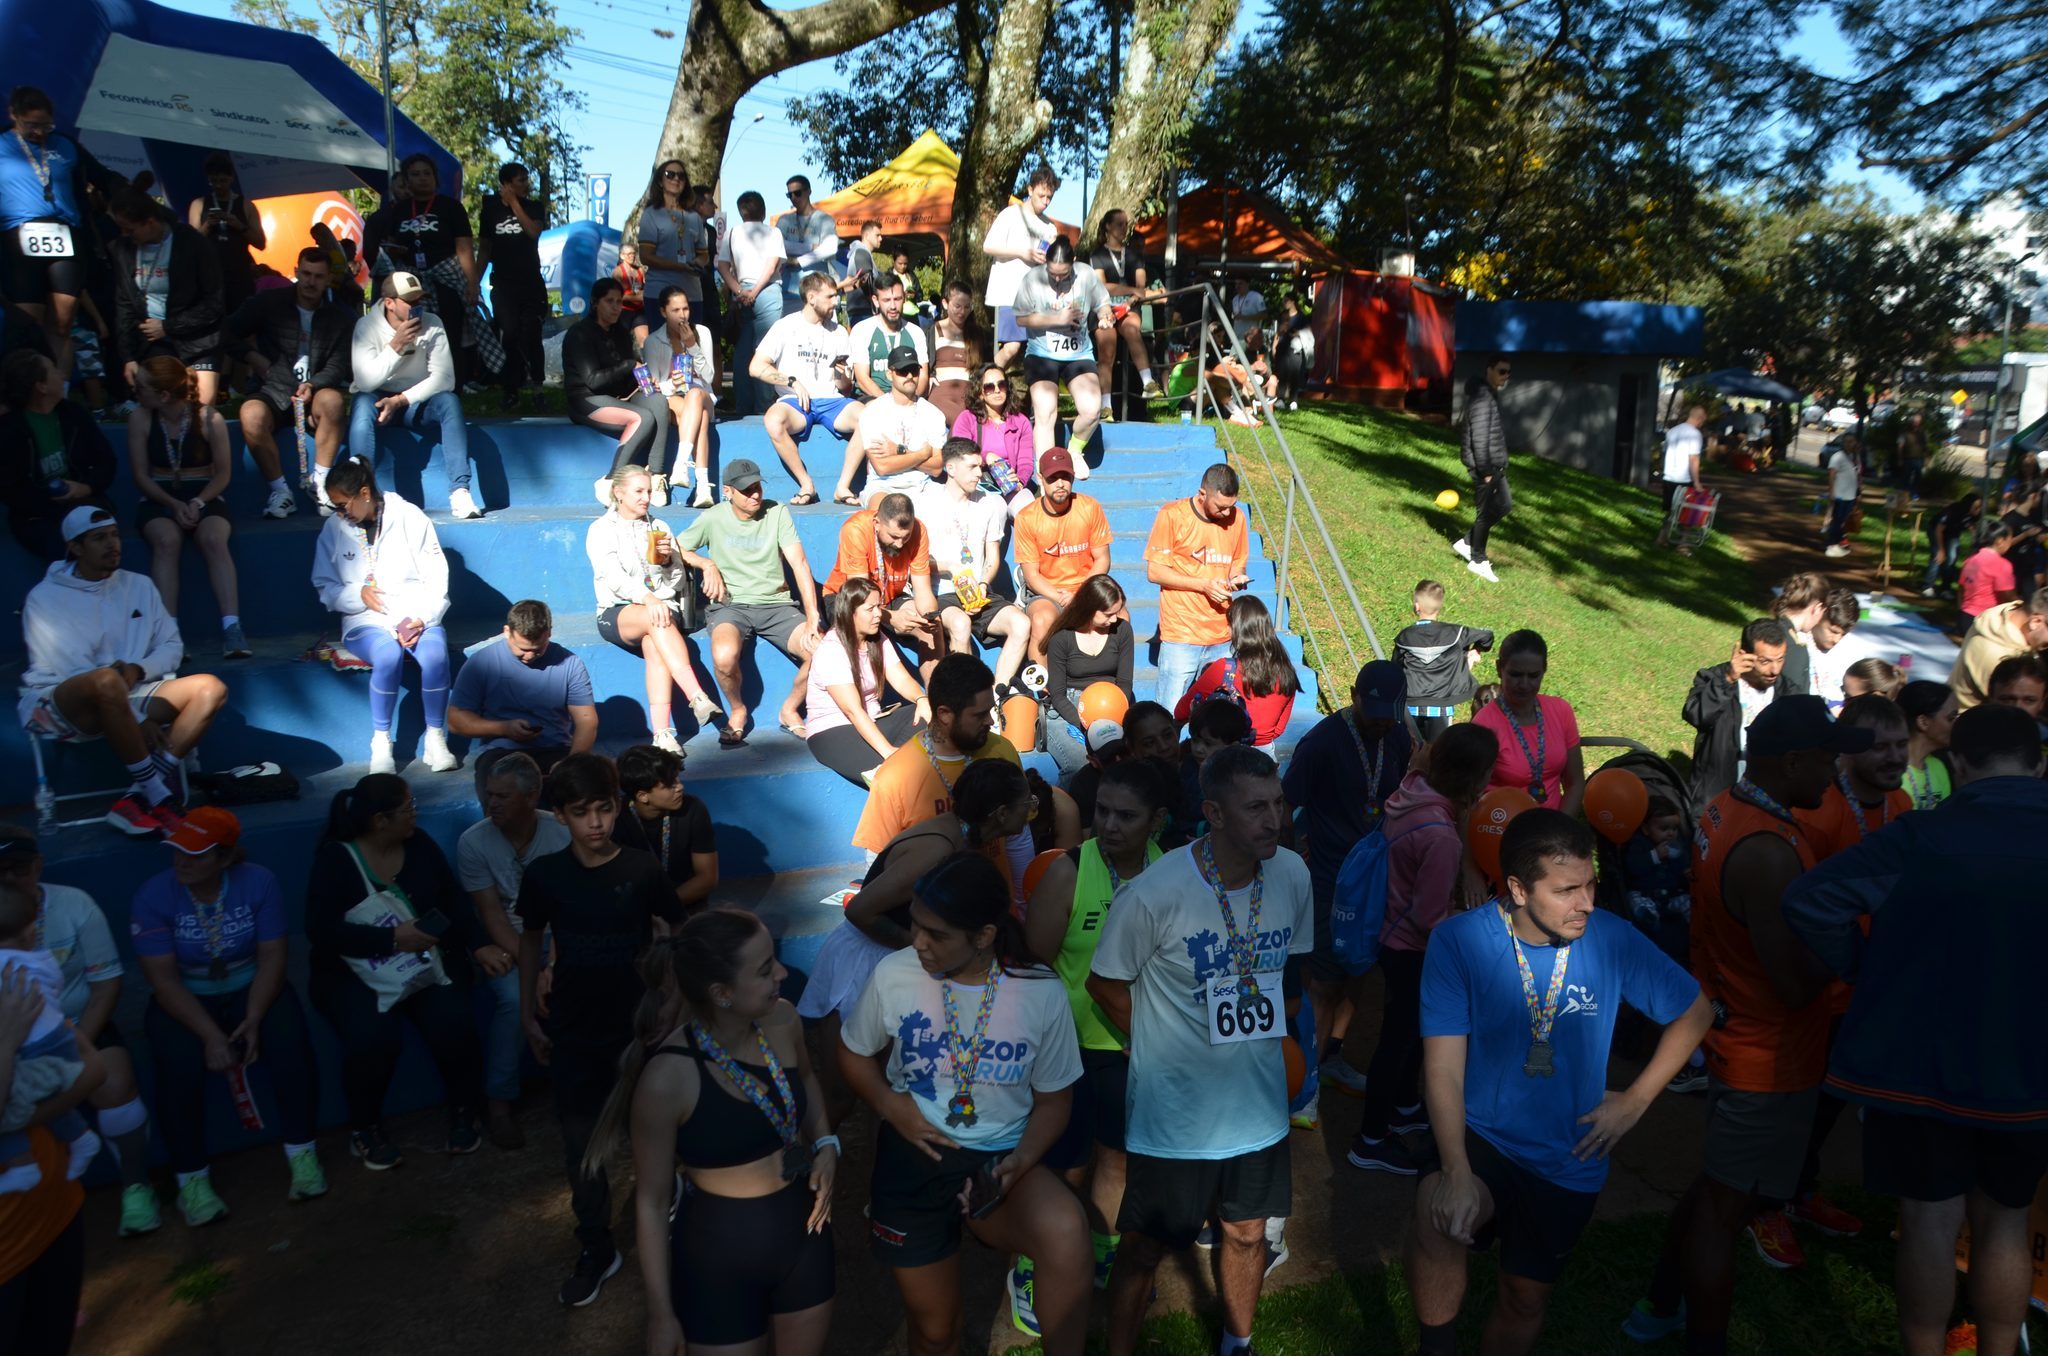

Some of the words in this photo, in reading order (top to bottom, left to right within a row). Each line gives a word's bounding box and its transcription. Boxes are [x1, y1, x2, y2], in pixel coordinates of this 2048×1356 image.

[495, 222, 523, 235] Ses
[28, 236, 65, 253] 853
[1052, 337, 1079, 352] 746
[1476, 825, 1504, 834] CRES
[1216, 997, 1275, 1037] 669
[975, 1061, 1028, 1082] RUN
